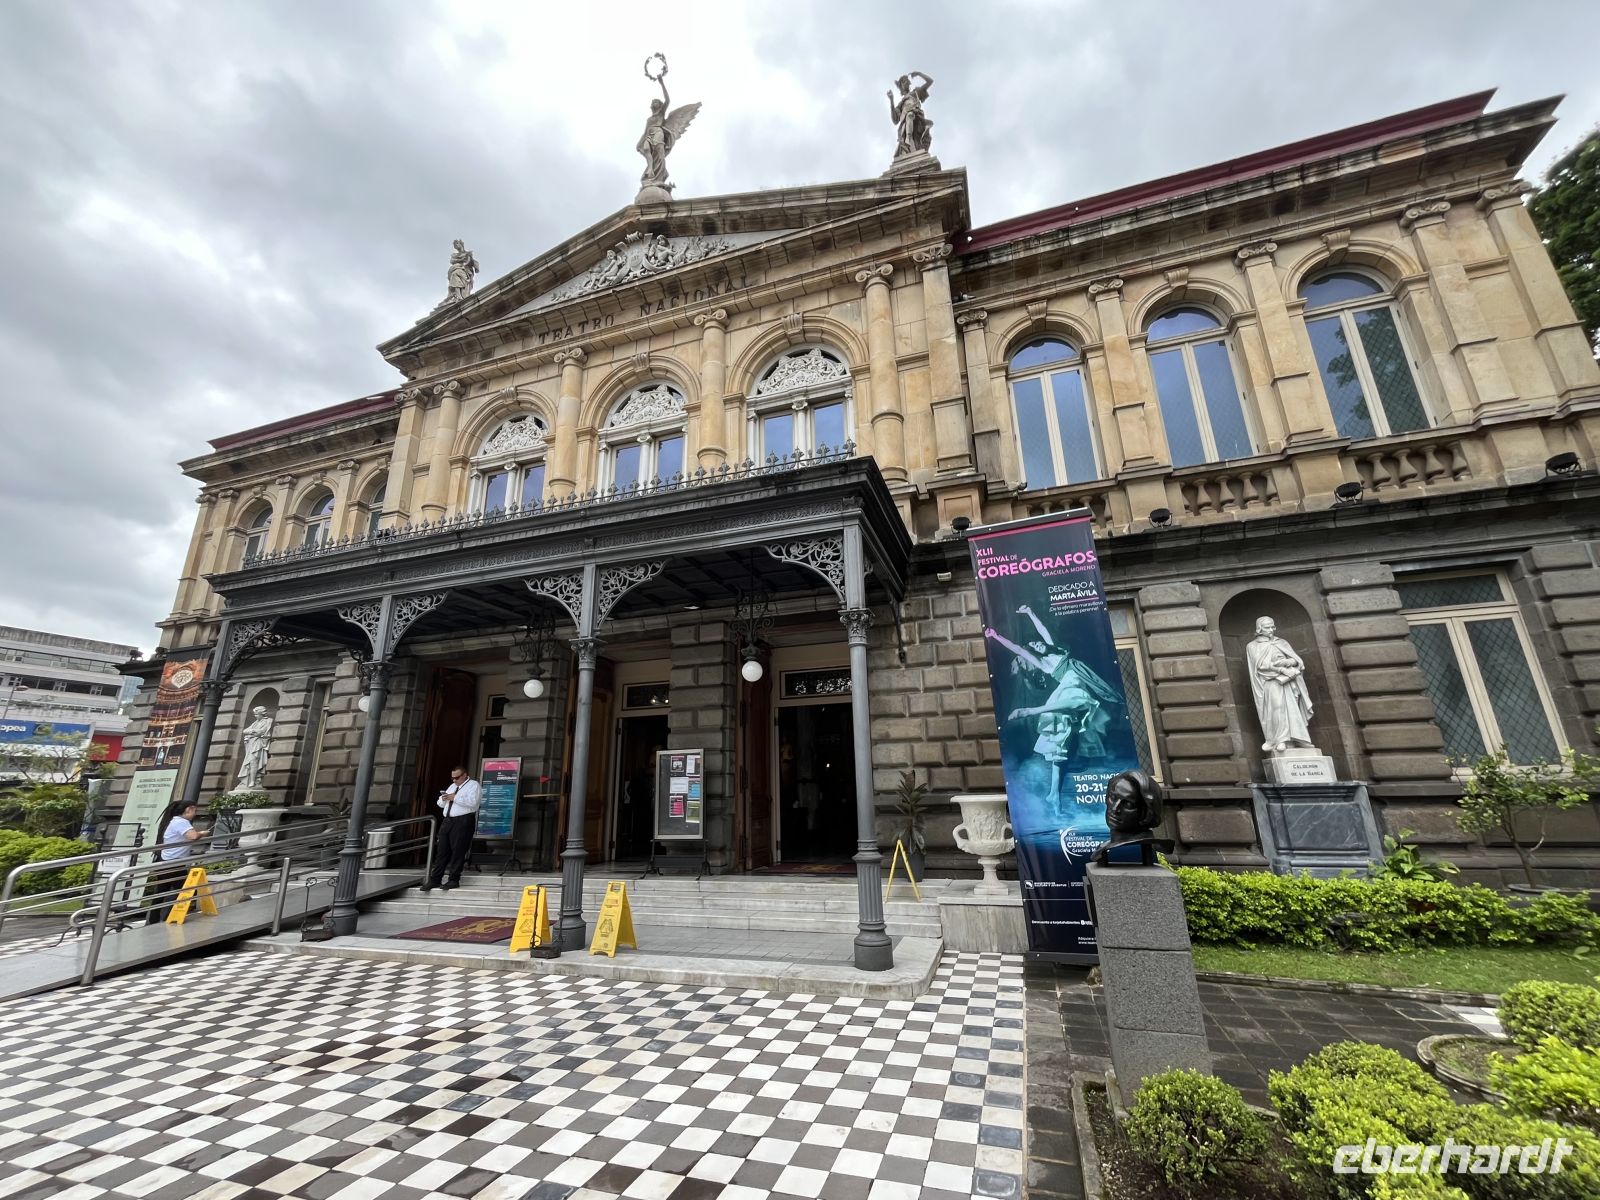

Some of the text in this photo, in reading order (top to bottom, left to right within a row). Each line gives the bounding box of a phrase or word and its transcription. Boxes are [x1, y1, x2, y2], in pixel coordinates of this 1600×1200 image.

[538, 275, 753, 344] TEATRO NACIONAL
[976, 547, 993, 557] XLII
[977, 555, 1009, 566] FESTIVAL
[978, 550, 1097, 579] COREÓGRAFOS
[1042, 564, 1096, 577] GRACIELA MORENO
[1048, 580, 1095, 594] DEDICADO A
[1050, 588, 1098, 602] MARTA ÁVILA
[1073, 772, 1120, 782] TEATRO NACI
